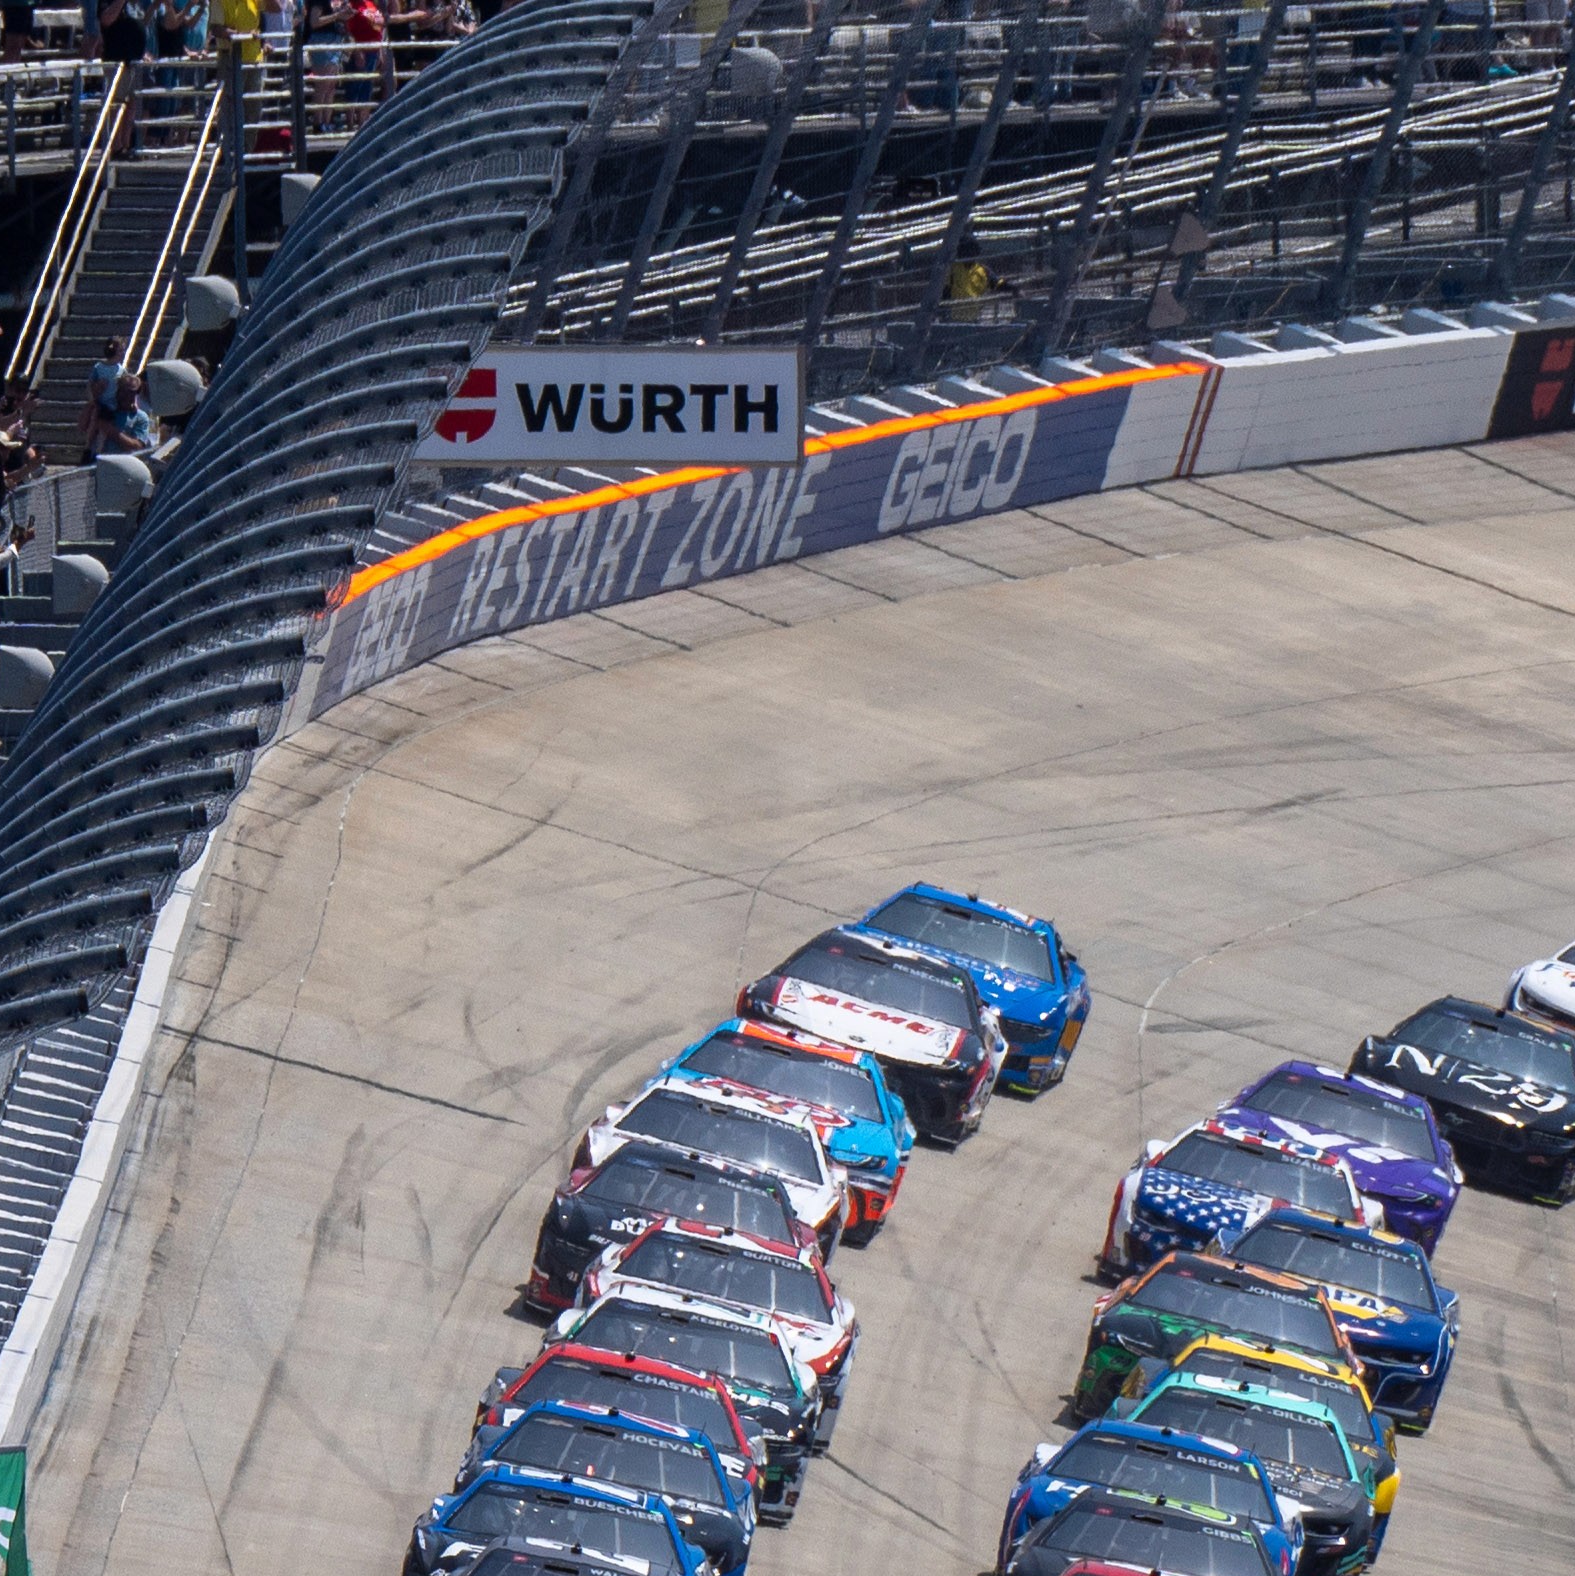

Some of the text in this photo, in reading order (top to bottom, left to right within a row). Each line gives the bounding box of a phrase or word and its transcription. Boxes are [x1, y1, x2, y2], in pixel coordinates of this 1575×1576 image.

[515, 383, 780, 435] WÜRTH
[878, 411, 1038, 534] GEICO
[447, 497, 663, 641] RESTART
[661, 455, 829, 588] ZONE
[807, 994, 934, 1034] ACME
[1352, 1241, 1409, 1263] ELLIOTT
[1246, 1285, 1319, 1310] JOHNSON
[622, 1433, 702, 1458] HOCEVAR
[1176, 1451, 1240, 1473] LARSON
